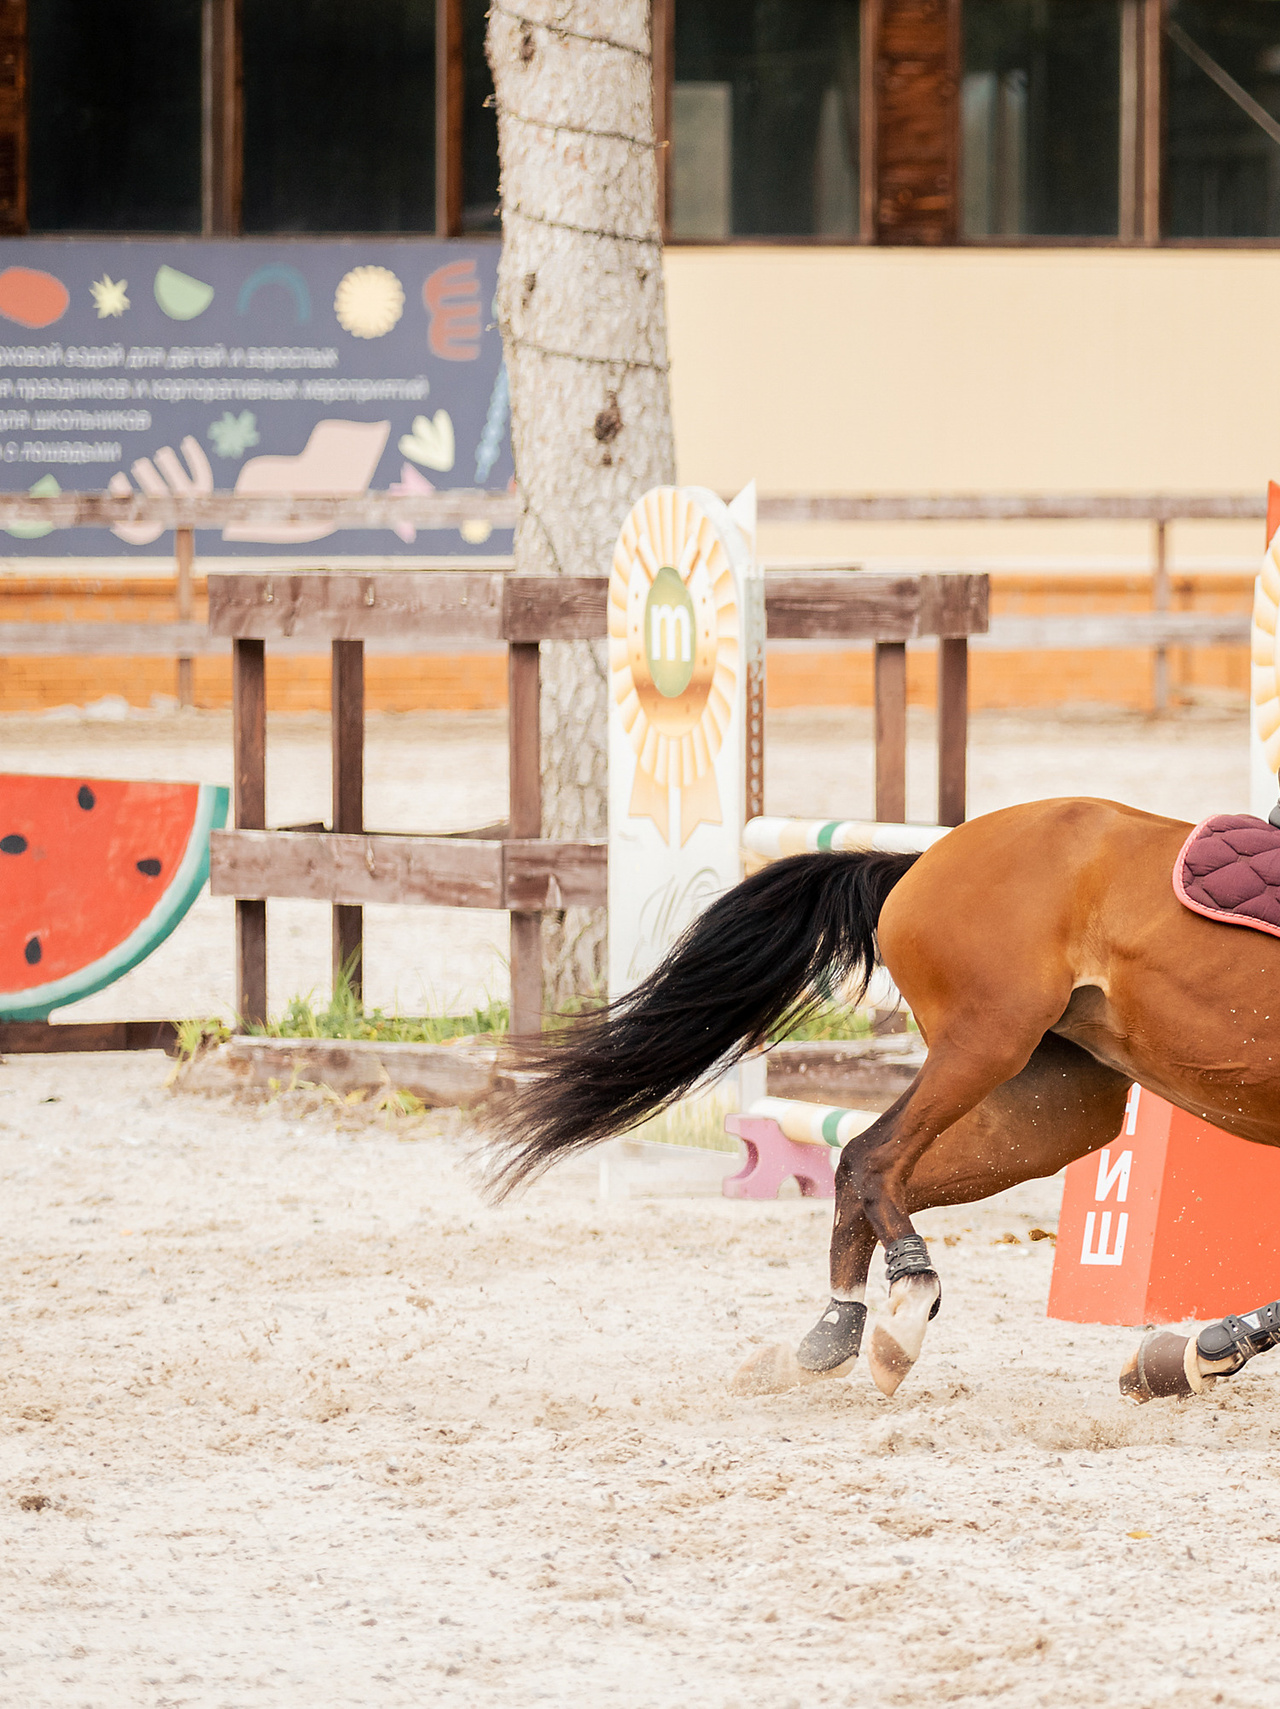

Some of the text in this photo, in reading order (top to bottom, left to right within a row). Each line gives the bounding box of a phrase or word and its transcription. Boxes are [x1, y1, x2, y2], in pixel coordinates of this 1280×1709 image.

[125, 346, 166, 369] для
[165, 342, 227, 370] детей
[650, 603, 692, 662] m
